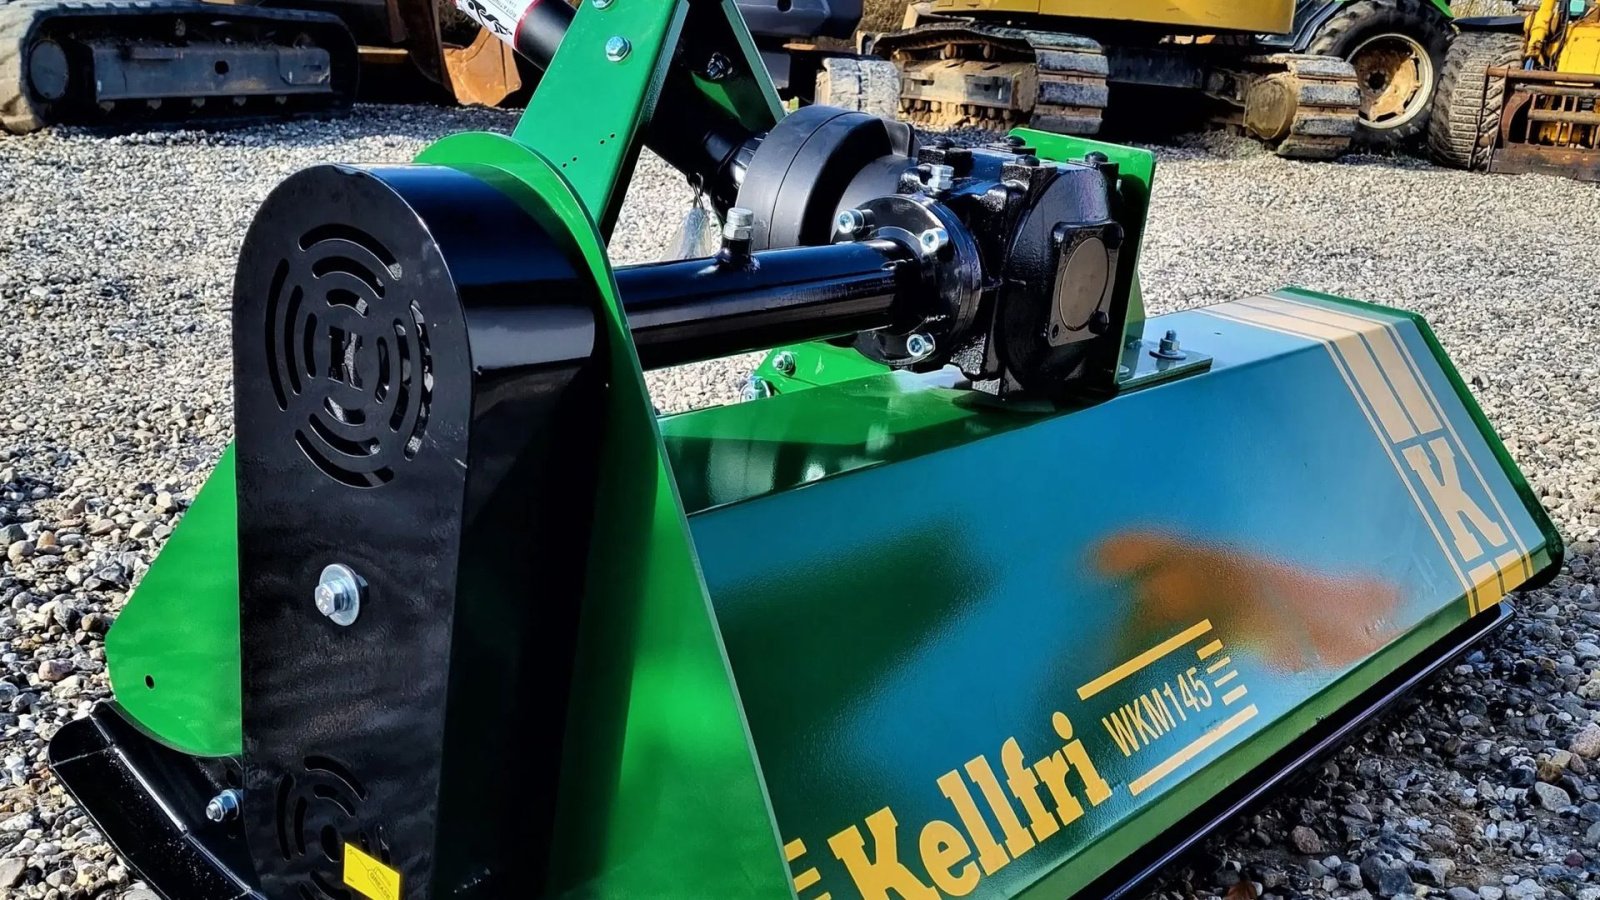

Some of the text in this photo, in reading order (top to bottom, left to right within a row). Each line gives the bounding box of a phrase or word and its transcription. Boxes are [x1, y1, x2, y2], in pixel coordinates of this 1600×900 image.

[328, 326, 363, 391] K
[1401, 436, 1508, 562] K
[1101, 666, 1212, 757] WKM145
[827, 711, 1112, 900] Kellfri
